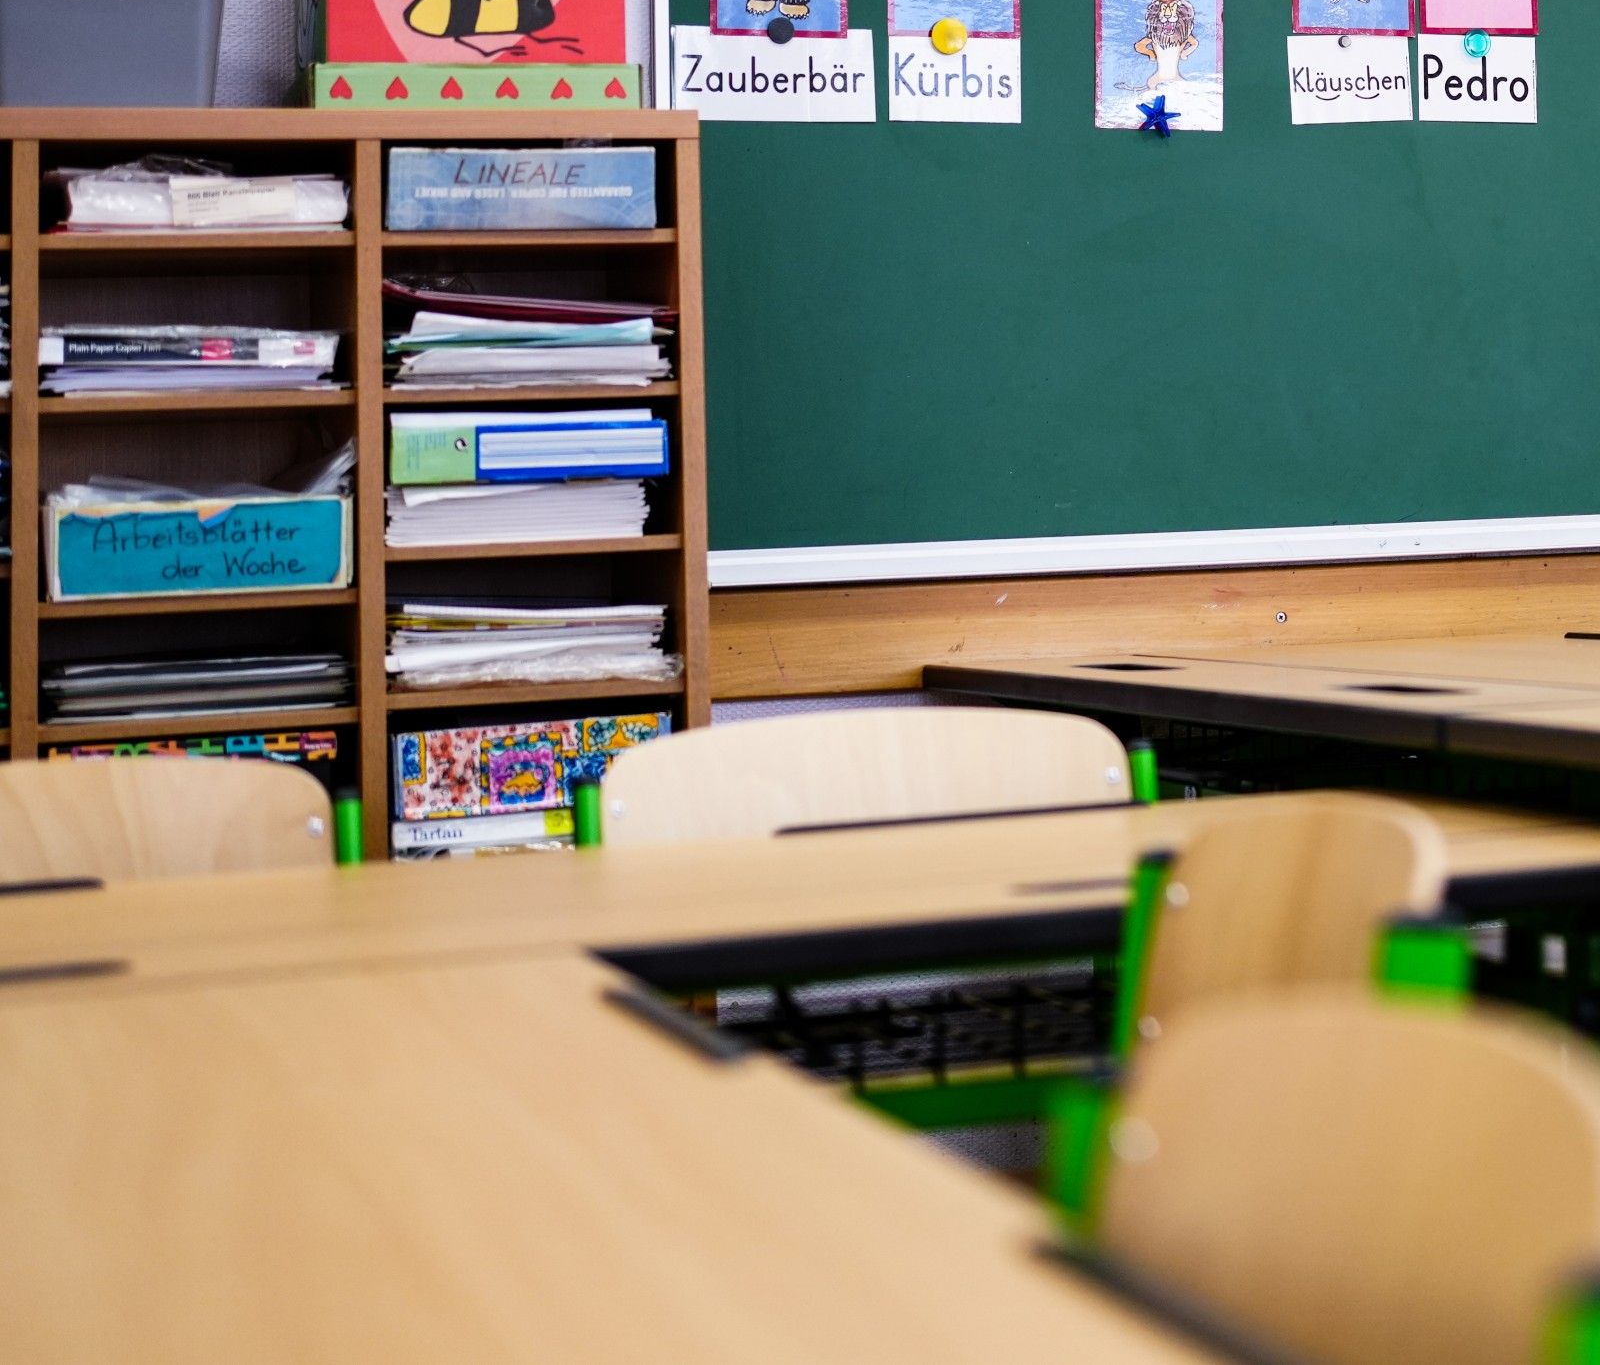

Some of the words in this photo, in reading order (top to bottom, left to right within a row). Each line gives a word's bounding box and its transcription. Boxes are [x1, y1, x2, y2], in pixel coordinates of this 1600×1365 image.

[682, 54, 866, 95] Zauberbär
[894, 53, 1013, 99] Kürbis
[1292, 66, 1407, 94] Kläuschen
[1424, 54, 1529, 102] Pedro
[454, 158, 585, 186] LINEALE
[92, 518, 302, 554] Arbeitsblätter
[162, 559, 203, 578] der
[224, 550, 306, 576] Woche
